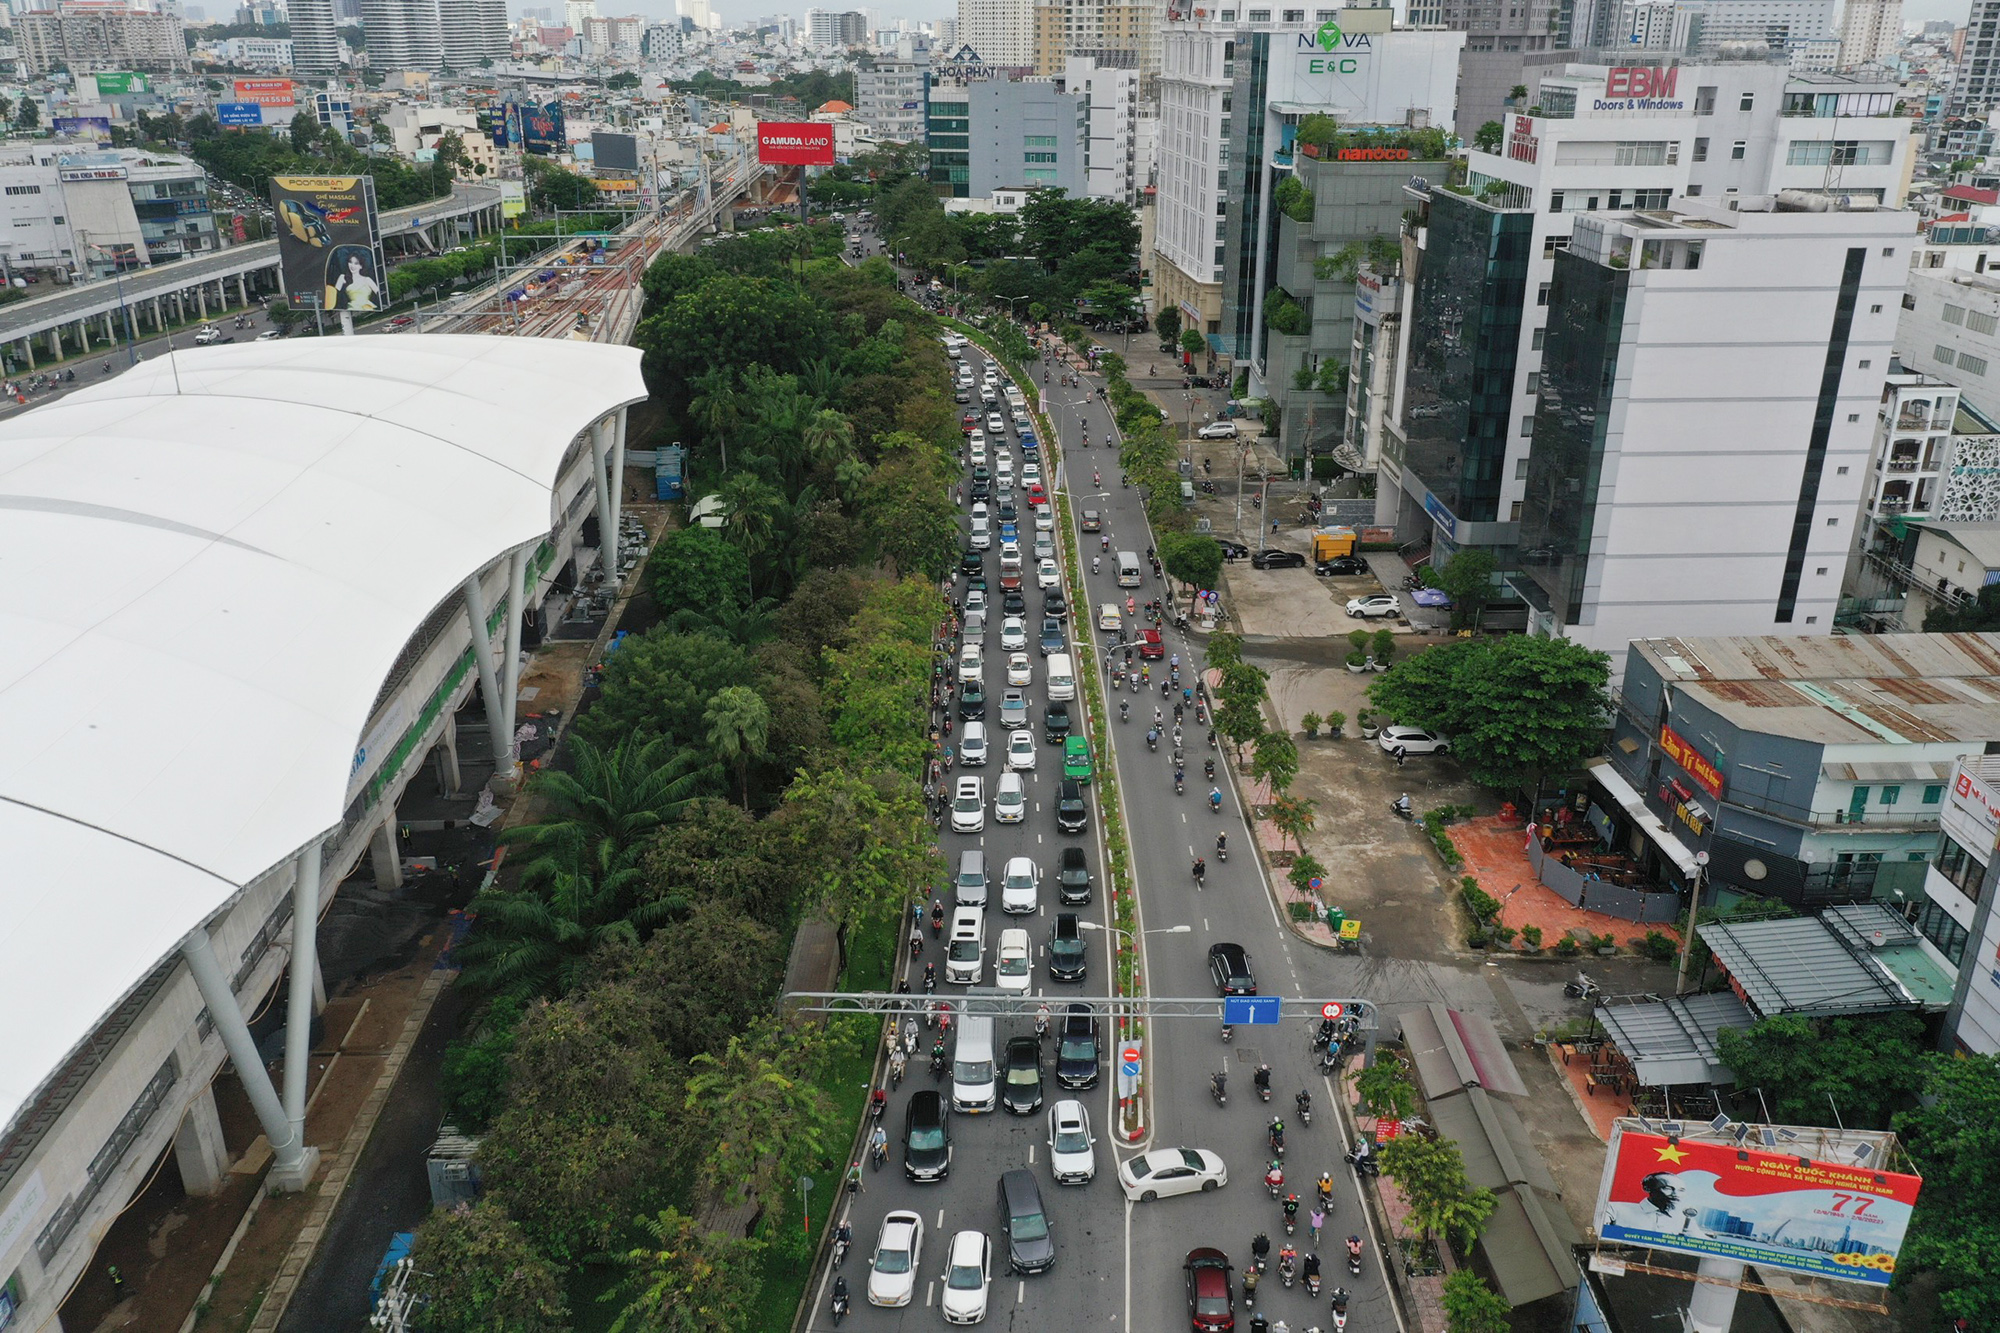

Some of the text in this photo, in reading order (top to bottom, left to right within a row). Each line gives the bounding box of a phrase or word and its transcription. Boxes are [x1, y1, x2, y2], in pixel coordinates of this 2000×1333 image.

[1310, 59, 1357, 74] E & C
[1606, 67, 1678, 98] EBM
[1594, 98, 1683, 110] Doors & Windows
[762, 136, 828, 146] GAMUDA LAND
[1735, 1164, 1755, 1172] NƯỚC
[1835, 1180, 1857, 1189] NGHĨA
[1760, 1161, 1872, 1184] NGÀY QUỐC KHÁNH
[1832, 1192, 1875, 1215] 77
